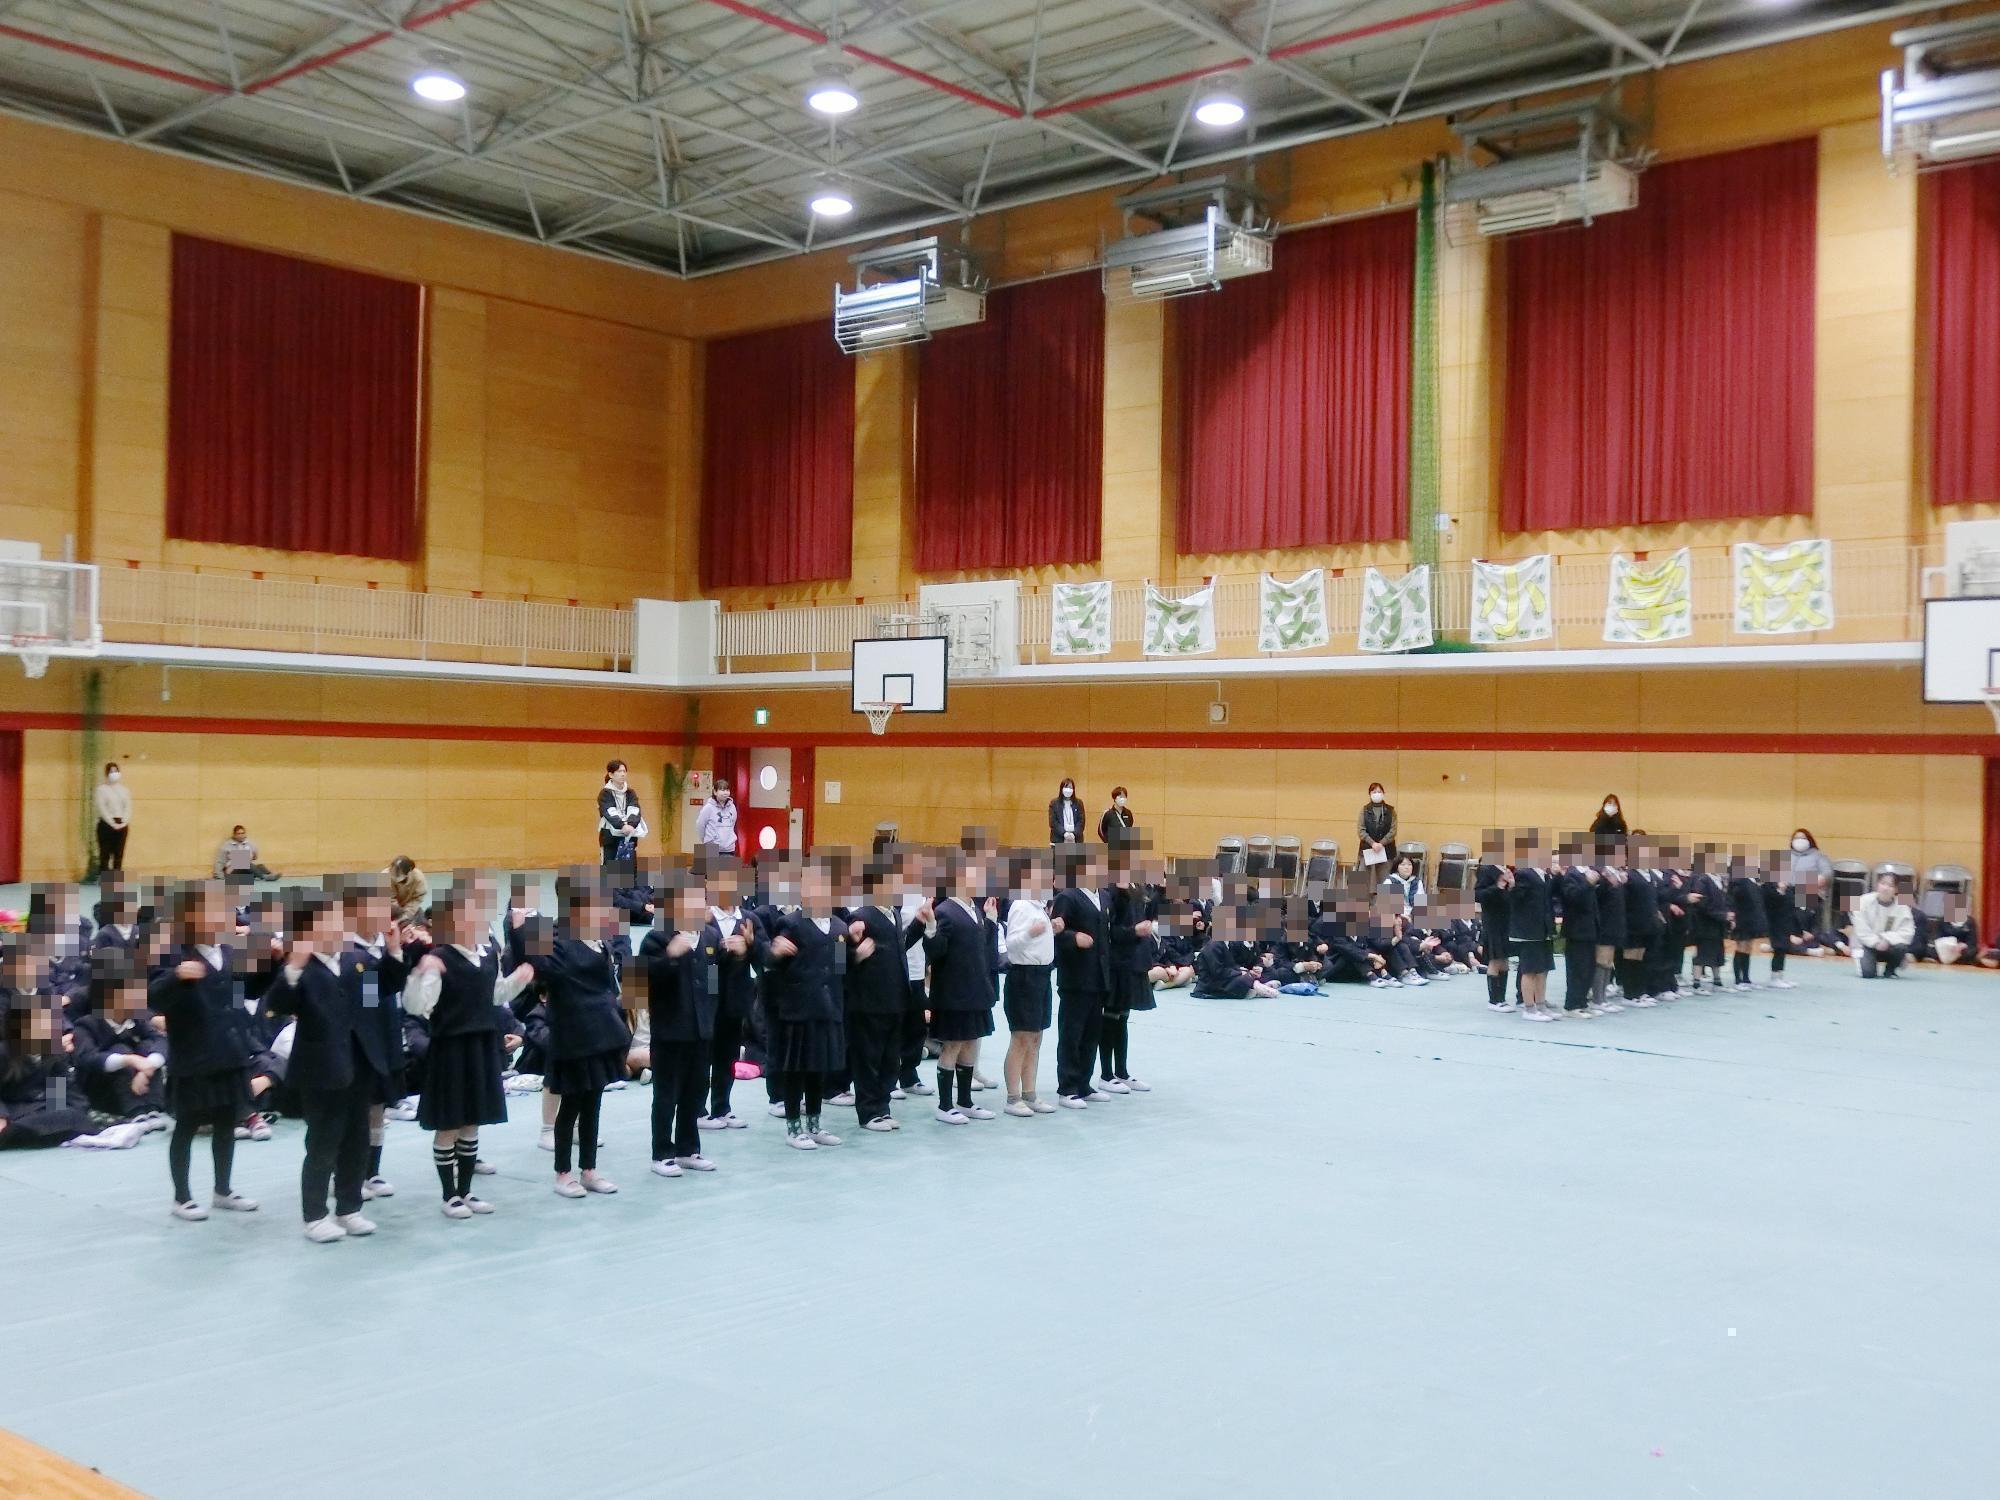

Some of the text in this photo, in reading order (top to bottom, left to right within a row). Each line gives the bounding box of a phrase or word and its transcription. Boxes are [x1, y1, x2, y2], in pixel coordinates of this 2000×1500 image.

[1480, 568, 1546, 637] 小
[1617, 560, 1690, 638] 学
[1740, 545, 1828, 629] 校
